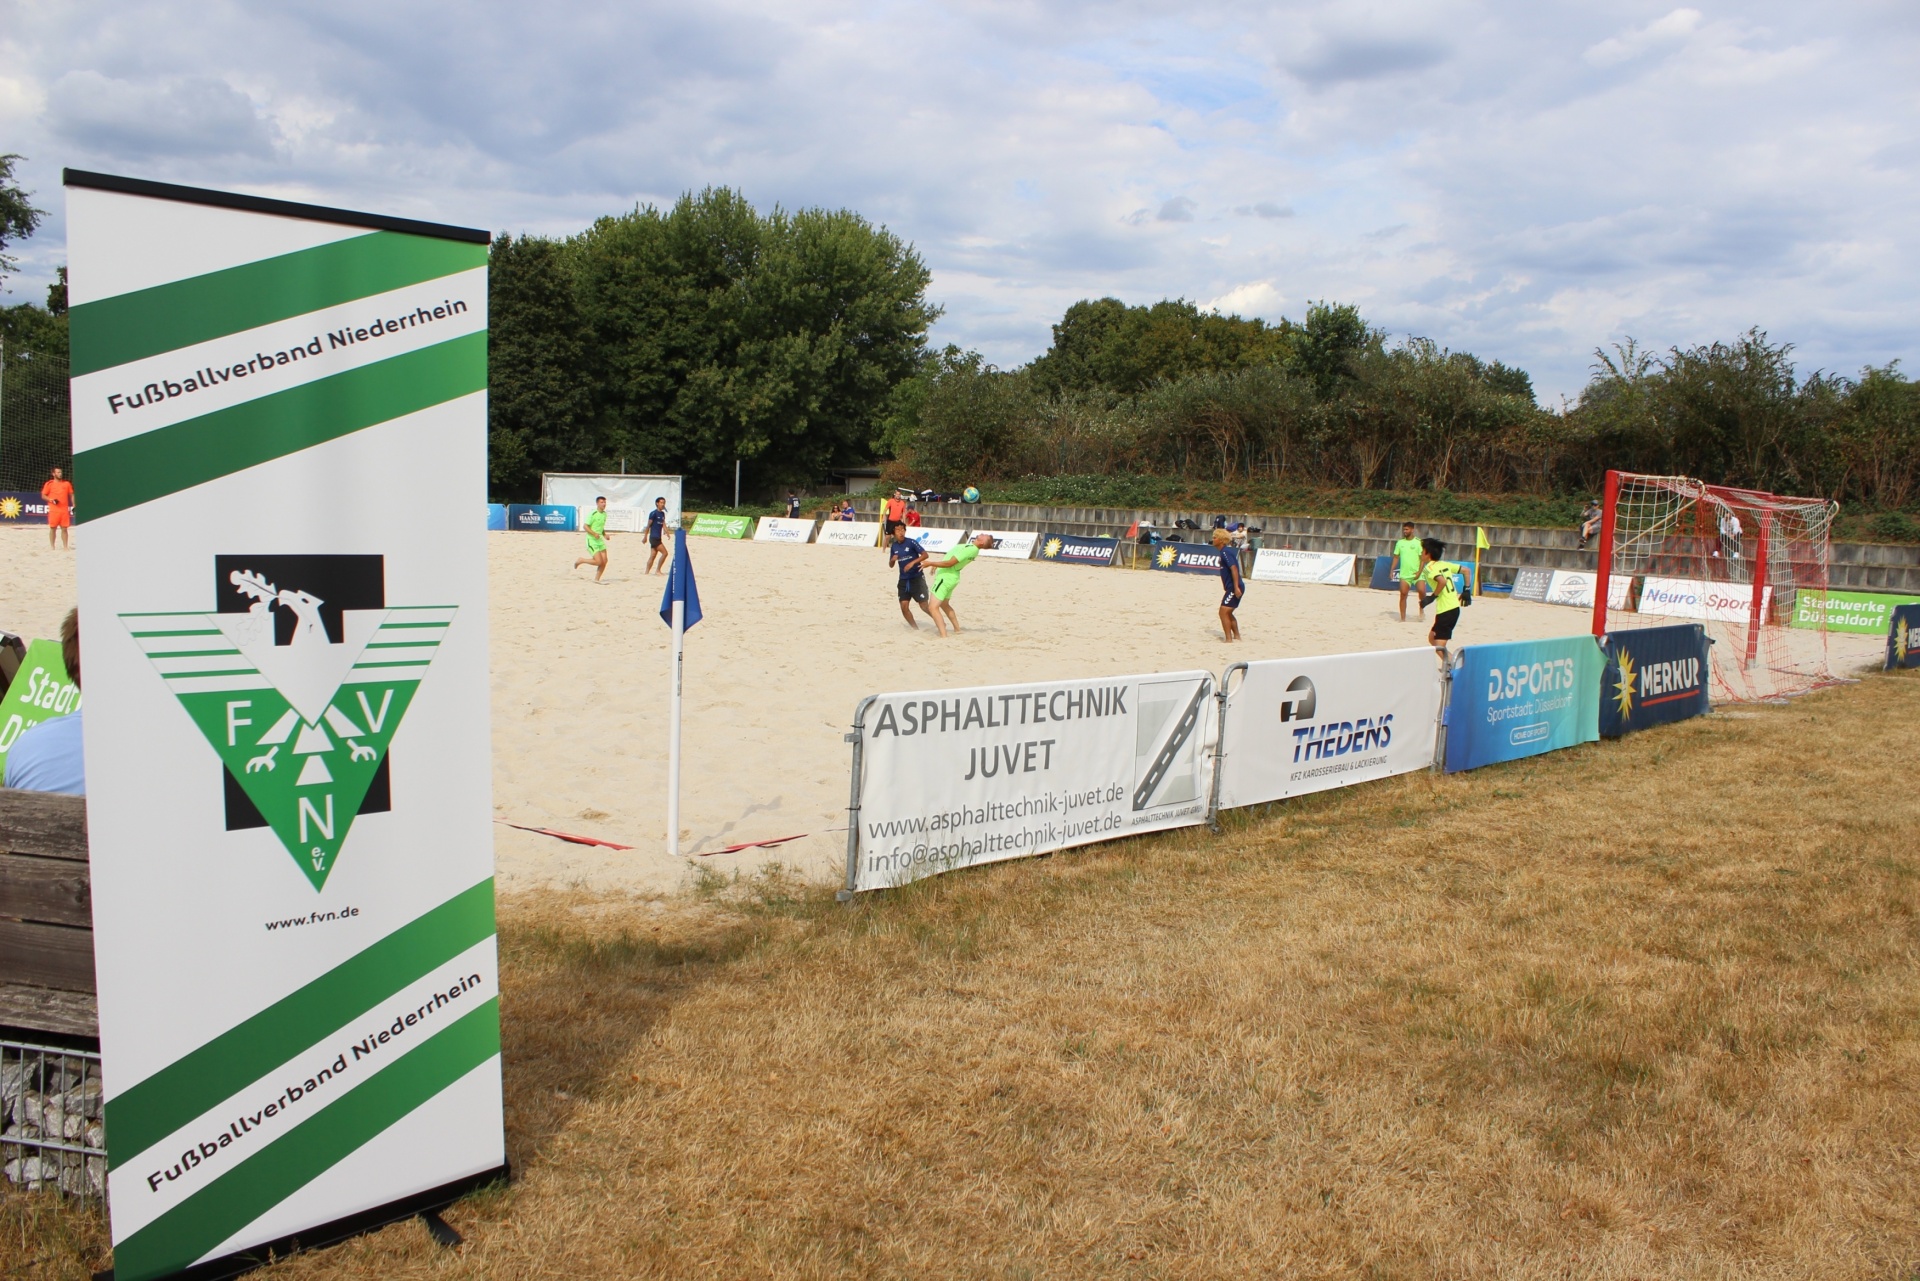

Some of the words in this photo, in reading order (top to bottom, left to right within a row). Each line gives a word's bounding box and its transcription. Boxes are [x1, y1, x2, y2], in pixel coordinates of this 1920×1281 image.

[107, 337, 323, 415] Fußballverband
[328, 298, 468, 350] Niederrhein
[25, 504, 75, 515] MERR
[829, 532, 867, 541] MYOKRAFT
[1062, 544, 1112, 558] MERKUR
[1178, 552, 1221, 568] MERKU
[1260, 550, 1322, 560] ASPHALTTECHNIK
[1799, 610, 1884, 627] Düsseldorf
[1802, 596, 1886, 613] Stadtwerke
[1488, 658, 1574, 702] D.SPORTS
[1641, 657, 1699, 698] MERKUR
[227, 700, 252, 746] F
[356, 689, 394, 734] V
[872, 685, 1128, 738] ASPHALTTECHNIK
[1487, 701, 1533, 726] Sportstadt
[1535, 692, 1573, 714] Düsseldorf
[1292, 713, 1394, 763] THEDENS
[1514, 730, 1527, 740] HOME
[965, 739, 1056, 780] JUVET
[1290, 771, 1302, 781] KFZ
[1303, 764, 1349, 779] KAROSSERIEBAU
[1354, 755, 1388, 770] LACKIERUNG
[298, 794, 334, 843] N
[869, 782, 1124, 838] www.asphalttechnik-juvet.de
[1131, 810, 1175, 826] ASPHALTTECHNIK
[1175, 807, 1190, 818] JUVET
[311, 846, 326, 858] e.
[868, 812, 1122, 872] info@asphalttechnik-juvet.de
[265, 906, 359, 931] www.fvn.de
[147, 1054, 348, 1193] Fußballverband
[352, 971, 482, 1061] Niederrhein
